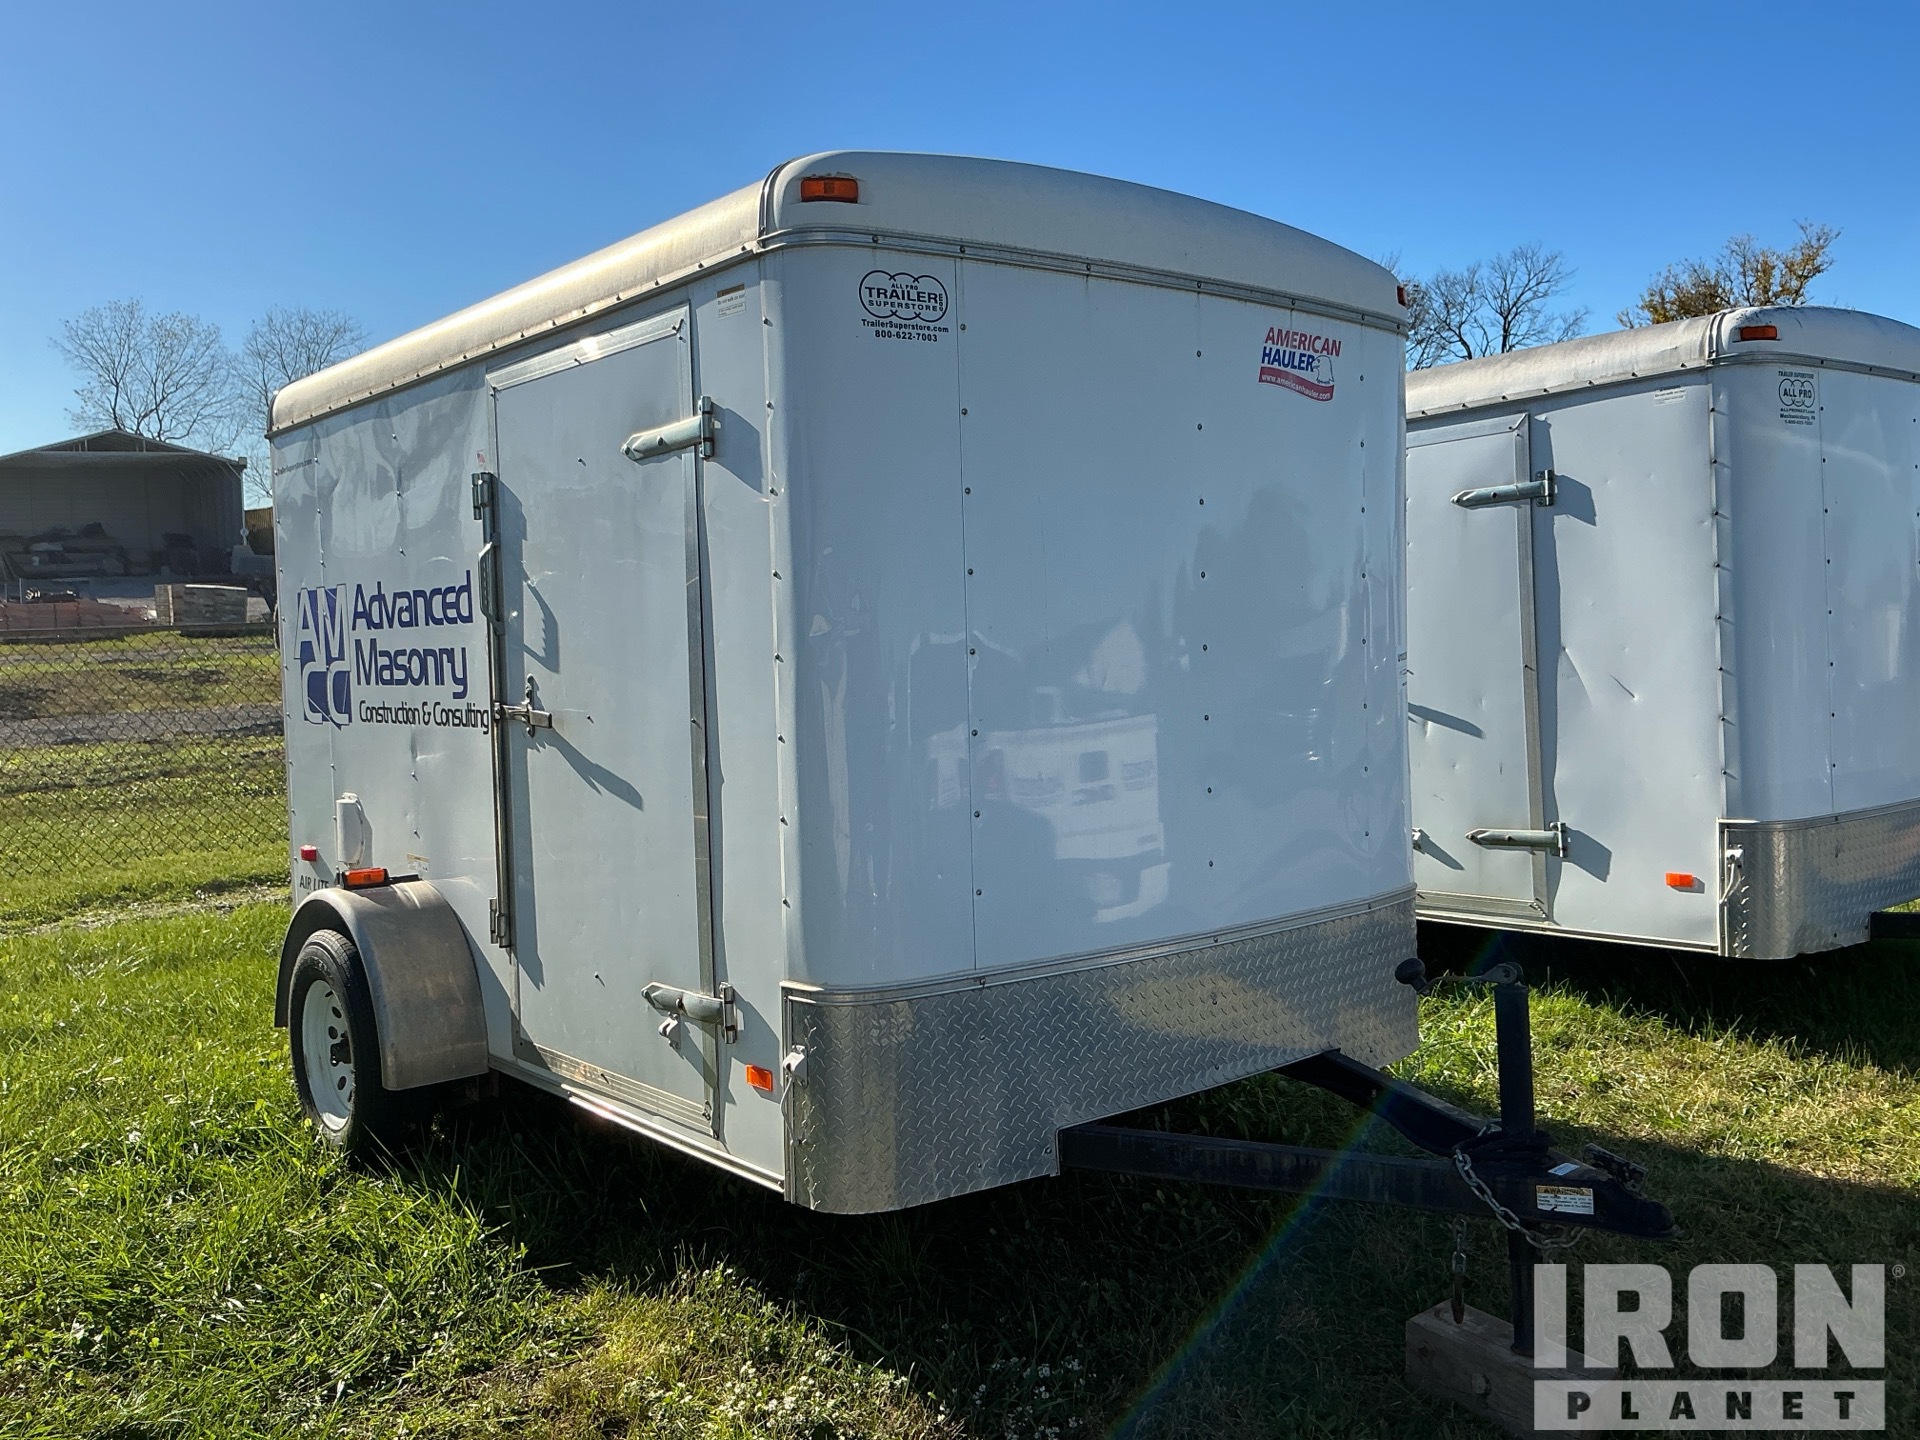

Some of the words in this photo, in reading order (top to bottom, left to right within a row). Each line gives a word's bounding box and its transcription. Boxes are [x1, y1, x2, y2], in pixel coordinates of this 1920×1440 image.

[864, 286, 938, 304] TRAILER
[868, 300, 938, 312] SUPERSTORE
[861, 319, 949, 333] TrailerSuperstore.com
[874, 330, 938, 342] 800-622-7003
[1264, 326, 1342, 357] AMERICAN
[1261, 346, 1315, 373] HAULER
[1261, 374, 1331, 400] www.americanhauler.com
[1783, 388, 1797, 397] ALL
[1798, 389, 1812, 399] PRO
[352, 569, 473, 631] Advanced
[355, 638, 468, 699] Masonry
[359, 700, 420, 725] Construction
[422, 701, 431, 725] &
[433, 701, 489, 735] Consulting
[299, 874, 312, 890] AIR
[313, 877, 330, 891] LITE
